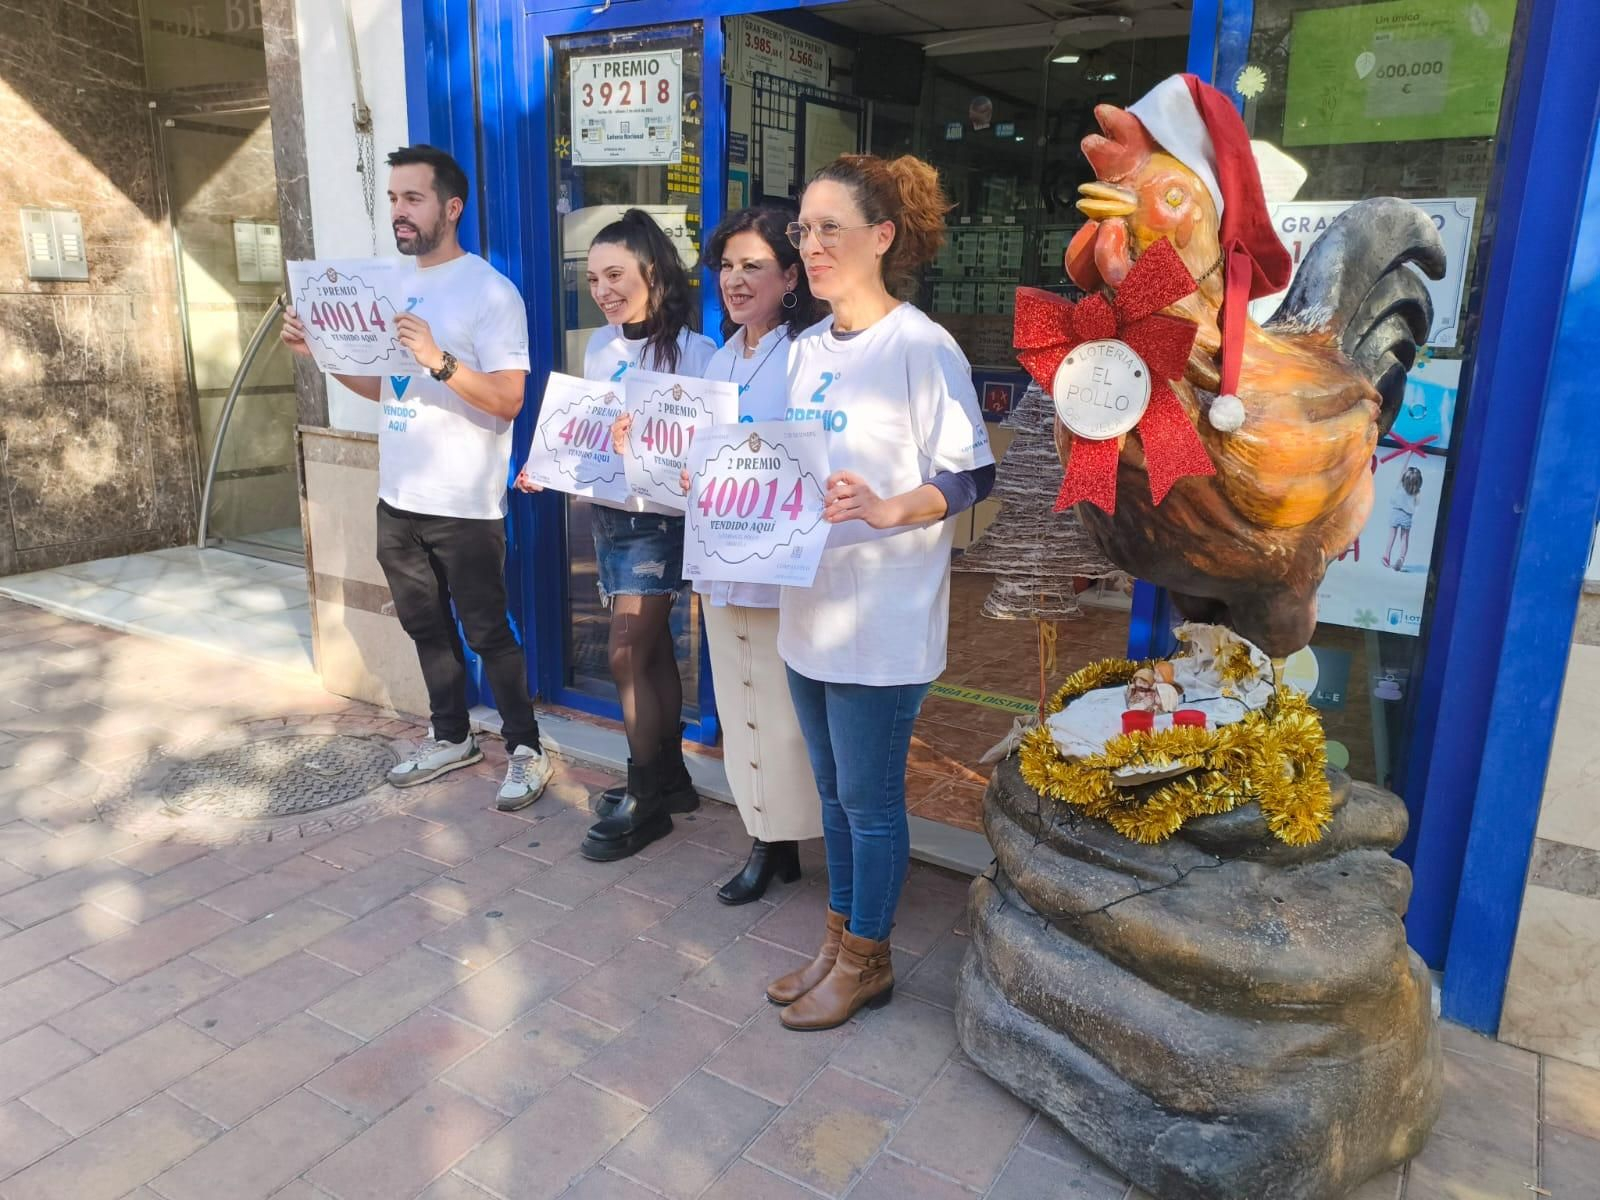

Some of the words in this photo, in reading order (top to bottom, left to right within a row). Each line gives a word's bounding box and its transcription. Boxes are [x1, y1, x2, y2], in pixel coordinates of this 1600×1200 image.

[1375, 15, 1390, 25] Un
[604, 58, 660, 79] PREMIO
[1375, 60, 1443, 79] 600.000
[581, 78, 671, 108] 39218
[1281, 216, 1334, 234] GRA
[322, 285, 358, 297] PREMIO
[310, 300, 387, 333] 40014
[330, 333, 360, 343] VENDIDO
[1078, 344, 1135, 370] LOTERIA
[1091, 366, 1113, 386] EL
[1066, 384, 1130, 411] POLLO
[383, 404, 418, 420] VENDIDO
[591, 405, 622, 418] PREMIO
[657, 401, 663, 413] 2
[663, 402, 698, 419] PREMIO
[388, 419, 408, 433] AQUÍ
[558, 415, 613, 454] 4001
[640, 415, 696, 459] 4001
[568, 448, 594, 460] VENDIDO
[653, 455, 682, 471] VENDIDO
[727, 457, 733, 470] 2
[735, 457, 782, 471] PREMIO
[697, 475, 804, 521] 40014
[709, 519, 749, 532] VENDIDO
[962, 691, 980, 701] LA
